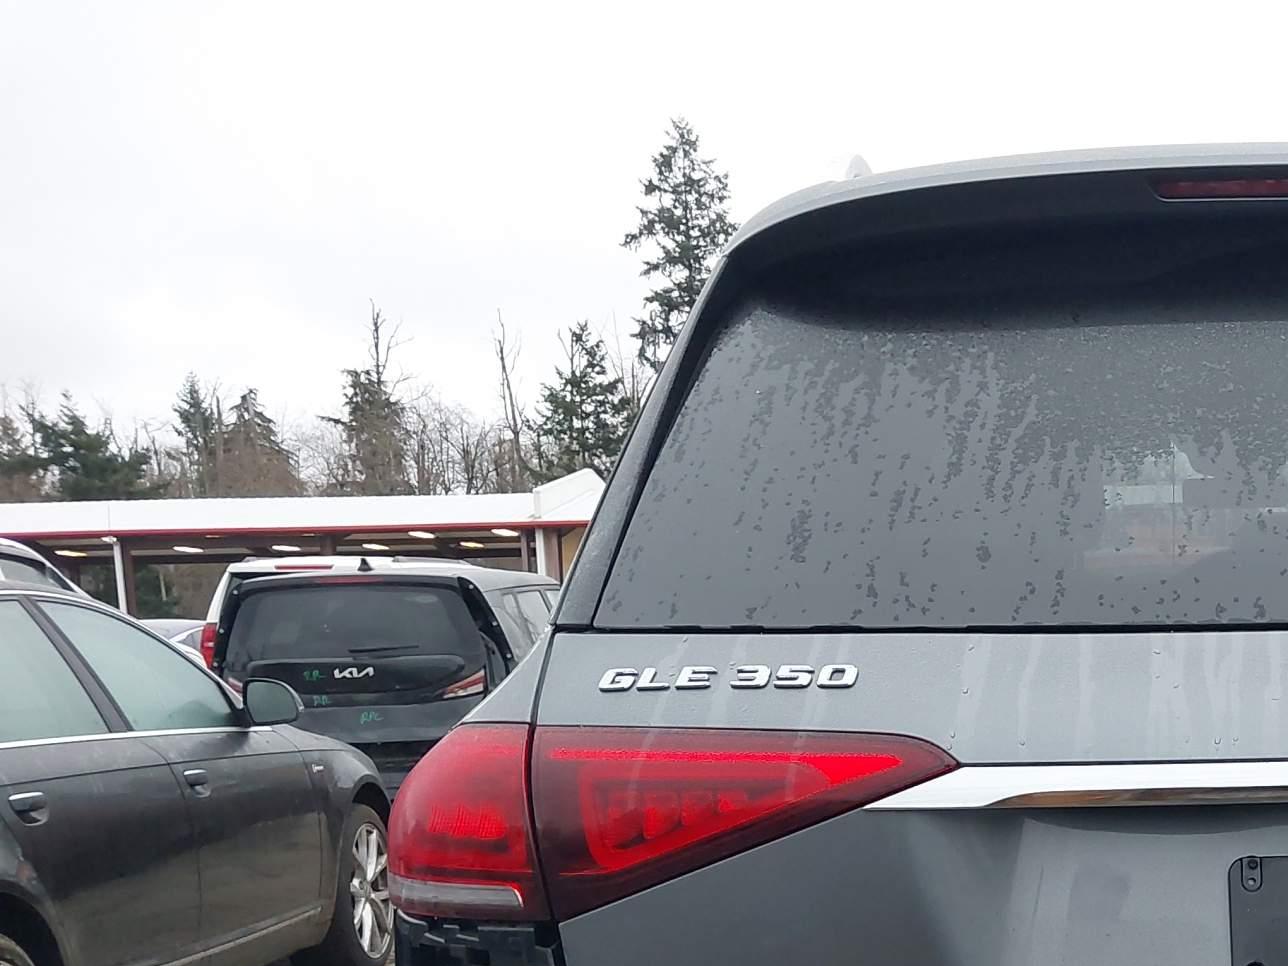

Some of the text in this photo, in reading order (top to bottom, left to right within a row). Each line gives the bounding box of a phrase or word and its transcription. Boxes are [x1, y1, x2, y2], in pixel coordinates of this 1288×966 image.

[333, 666, 374, 679] KIA
[599, 664, 859, 692] GLE 350
